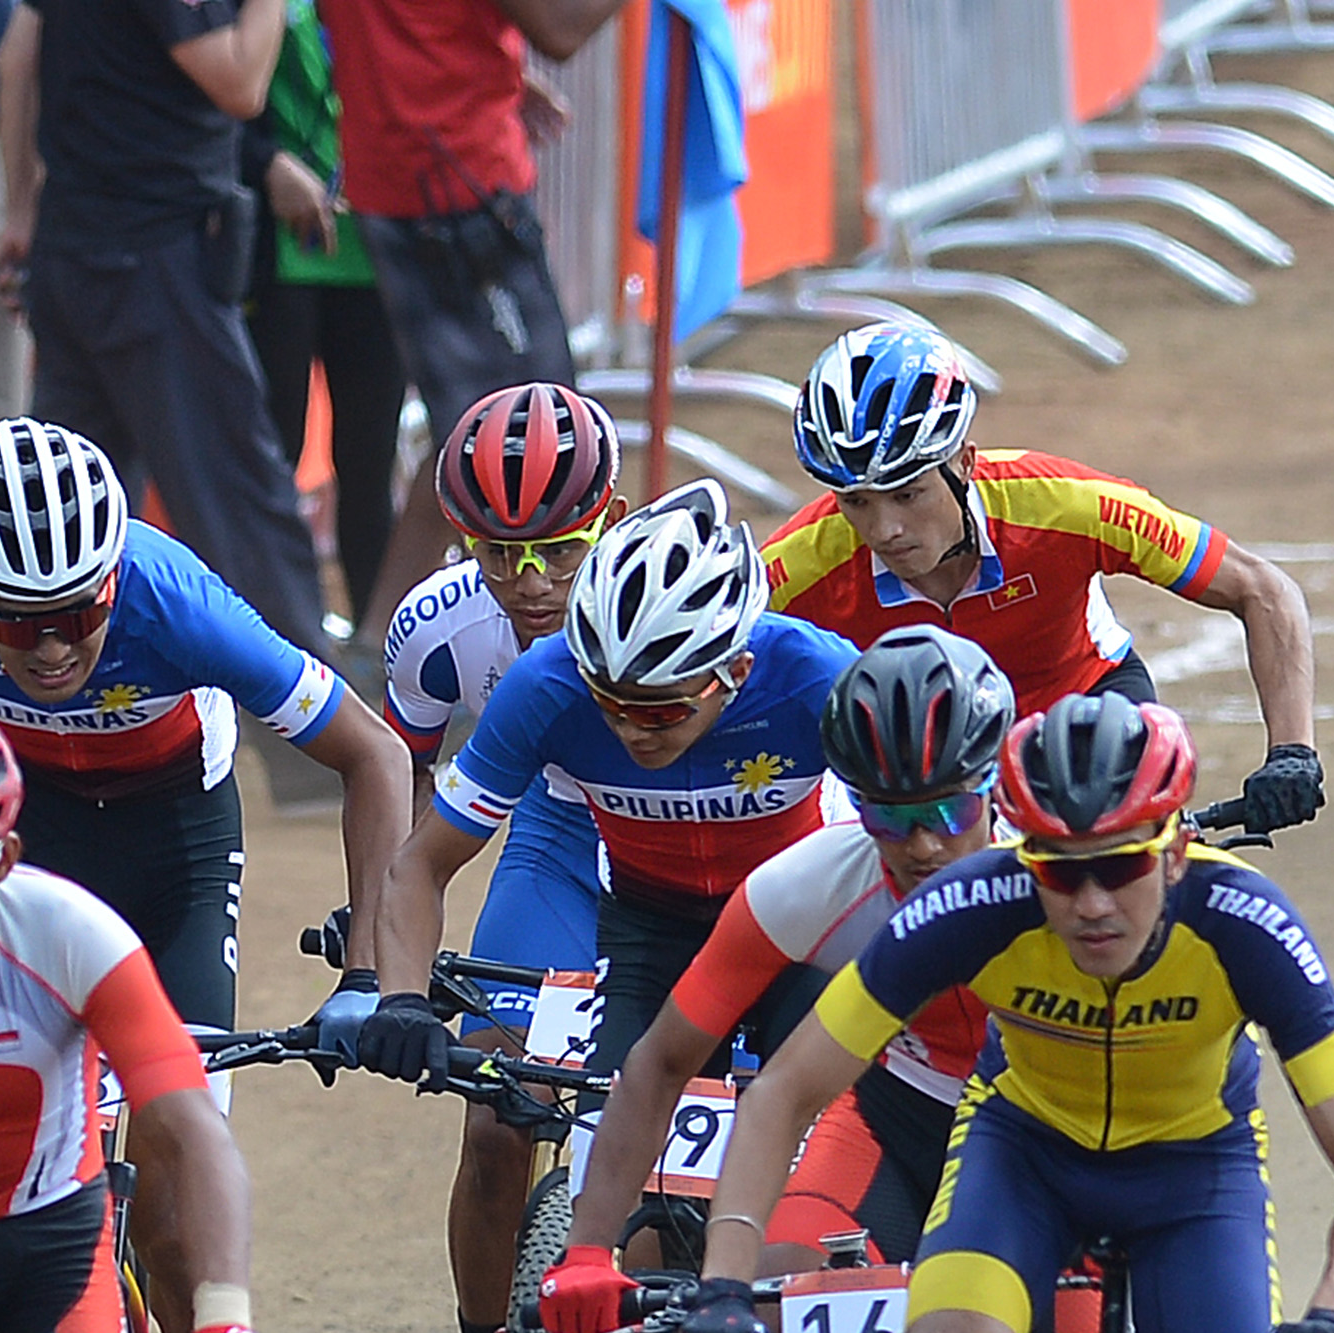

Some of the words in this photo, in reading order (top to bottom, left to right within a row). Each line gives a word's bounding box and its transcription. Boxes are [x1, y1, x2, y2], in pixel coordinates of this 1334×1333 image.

[1098, 494, 1186, 563] VIETNAM
[602, 788, 786, 821] PILIPINAS
[889, 872, 1032, 940] THAILAND
[1207, 883, 1327, 985] THAILAND
[1010, 986, 1199, 1029] THAILAND
